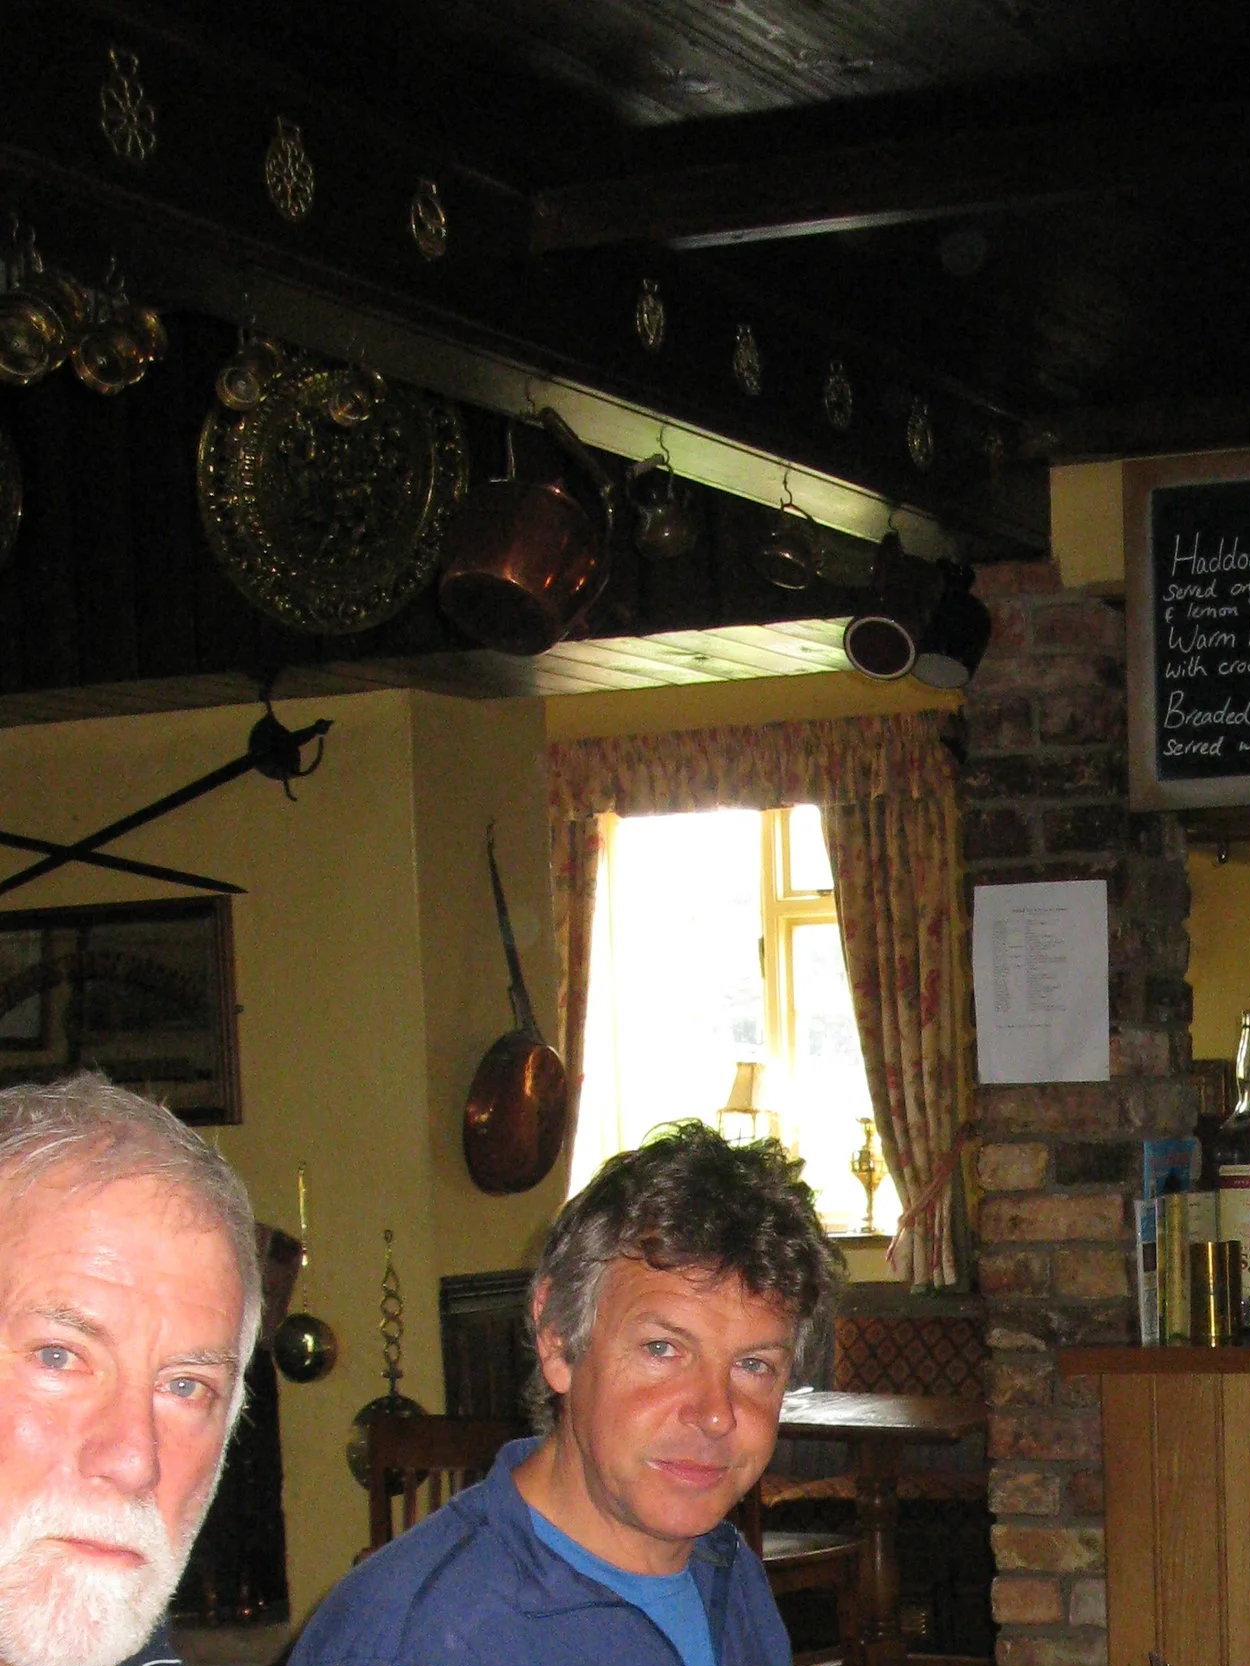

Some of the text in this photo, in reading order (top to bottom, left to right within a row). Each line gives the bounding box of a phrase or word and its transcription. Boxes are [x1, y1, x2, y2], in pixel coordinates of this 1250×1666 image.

[1163, 578, 1218, 601] served
[1187, 602, 1239, 618] lemon
[1168, 624, 1236, 653] Warm
[1165, 655, 1208, 679] with
[1163, 735, 1225, 757] served
